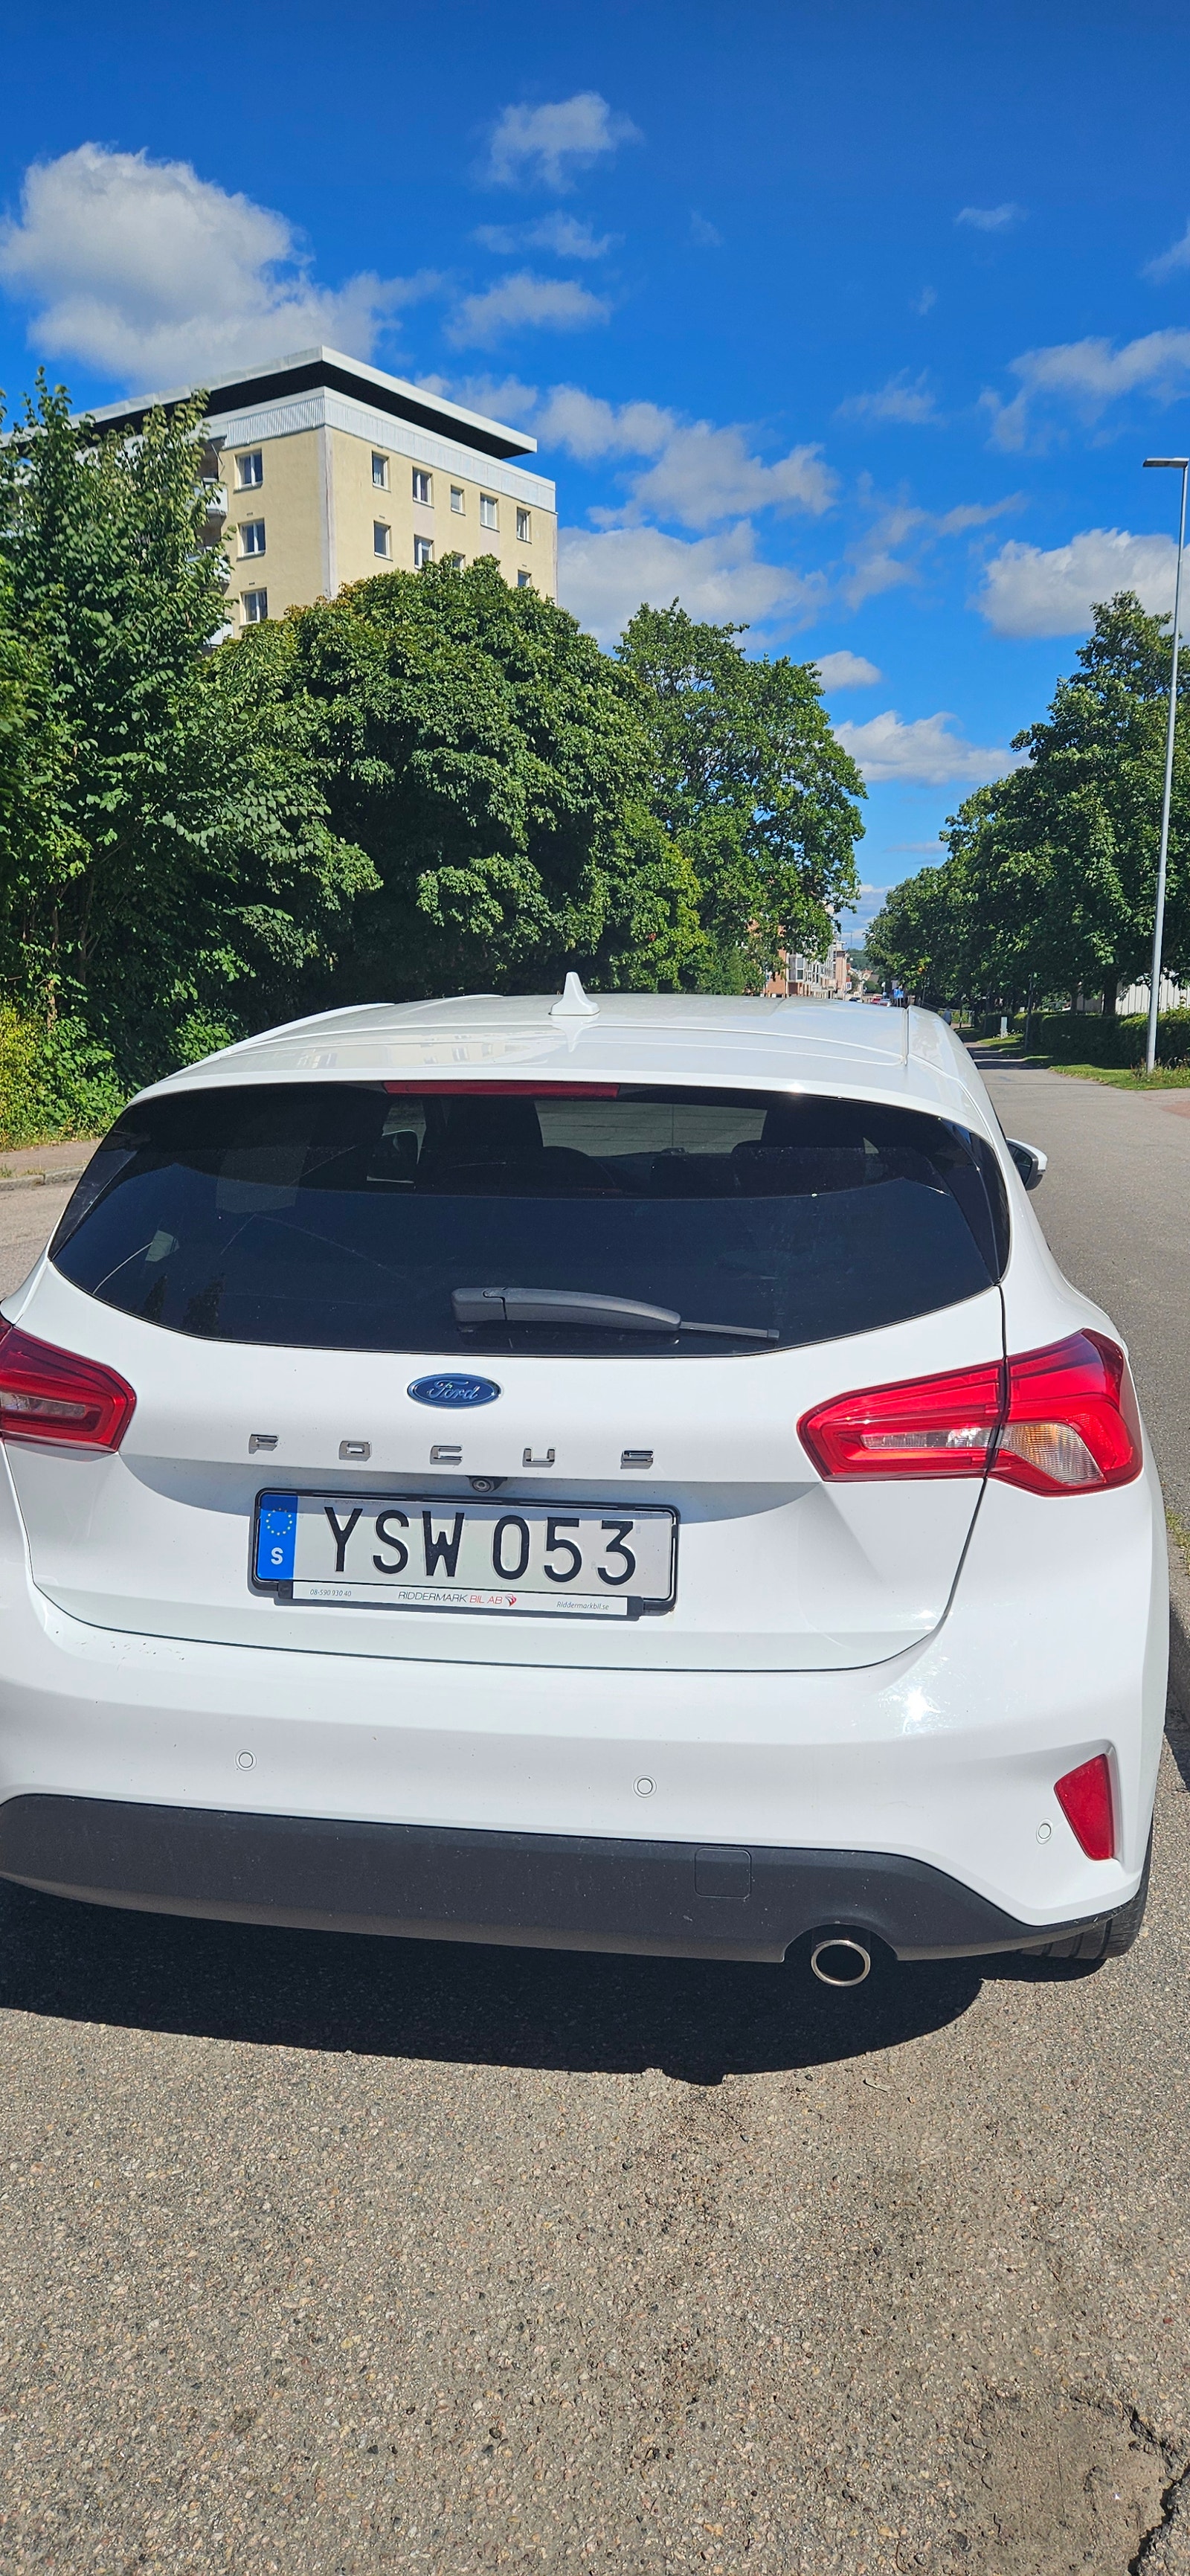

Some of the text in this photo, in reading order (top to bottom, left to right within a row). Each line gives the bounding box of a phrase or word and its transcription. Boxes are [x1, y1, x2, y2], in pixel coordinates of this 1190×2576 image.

[426, 1380, 480, 1400] Ford
[248, 1433, 654, 1470] FOCUS
[270, 1547, 284, 1565] S
[324, 1506, 636, 1587] YSW 053
[398, 1590, 504, 1605] RIDDERMARK BIL AB
[556, 1601, 610, 1611] Riddermarkbil.se
